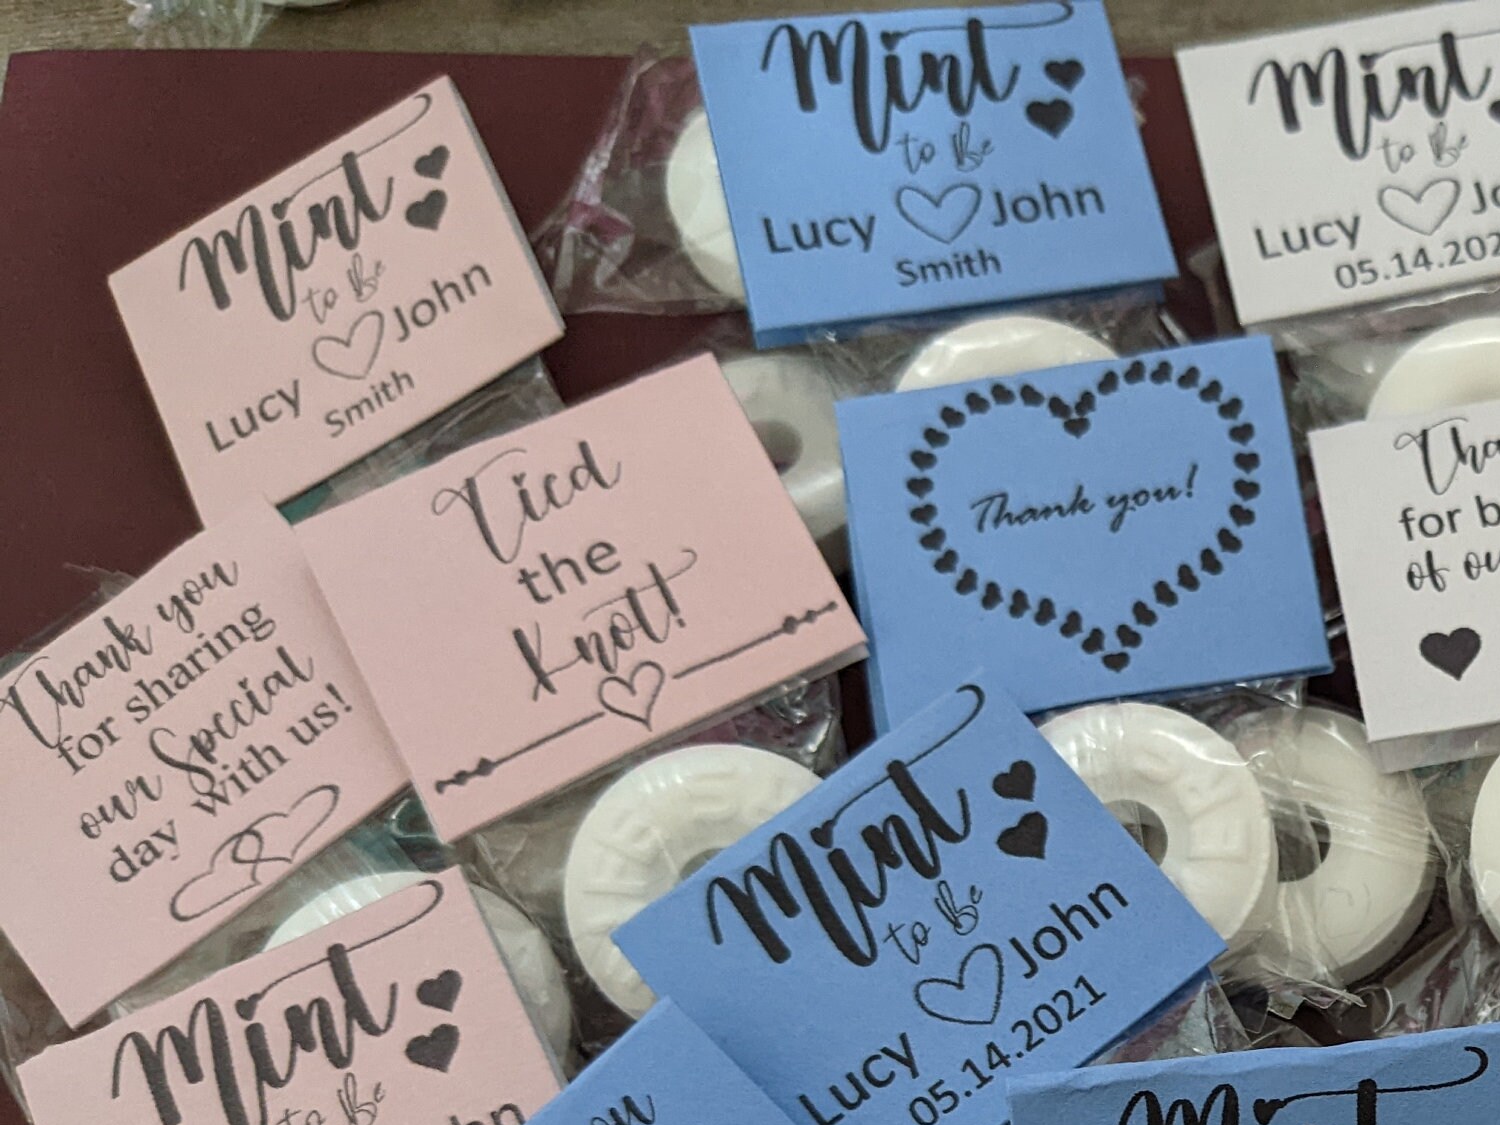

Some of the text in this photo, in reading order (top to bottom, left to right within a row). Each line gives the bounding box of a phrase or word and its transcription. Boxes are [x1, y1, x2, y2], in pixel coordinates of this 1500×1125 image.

[761, 0, 1074, 154] Mint
[895, 132, 936, 175] to
[1377, 137, 1416, 174] to
[179, 93, 432, 322] Mint
[762, 182, 1105, 254] Lucy John
[1254, 214, 1360, 259] Lucy
[896, 248, 1001, 287] Smith
[301, 287, 339, 325] to
[205, 264, 492, 453] Lucy John
[324, 370, 414, 438] Smith
[431, 440, 620, 564] Tied
[970, 462, 1198, 533] Thank you!
[1399, 507, 1461, 541] for
[517, 541, 621, 604] the
[1407, 550, 1449, 592] of
[0, 562, 237, 749] Thank you
[512, 548, 697, 700] Knot!
[56, 604, 277, 775] for sharing
[80, 645, 315, 839] our Special
[109, 683, 352, 883] day with us!
[705, 683, 985, 967] Mint
[883, 921, 931, 965] to
[1009, 883, 1128, 979] John
